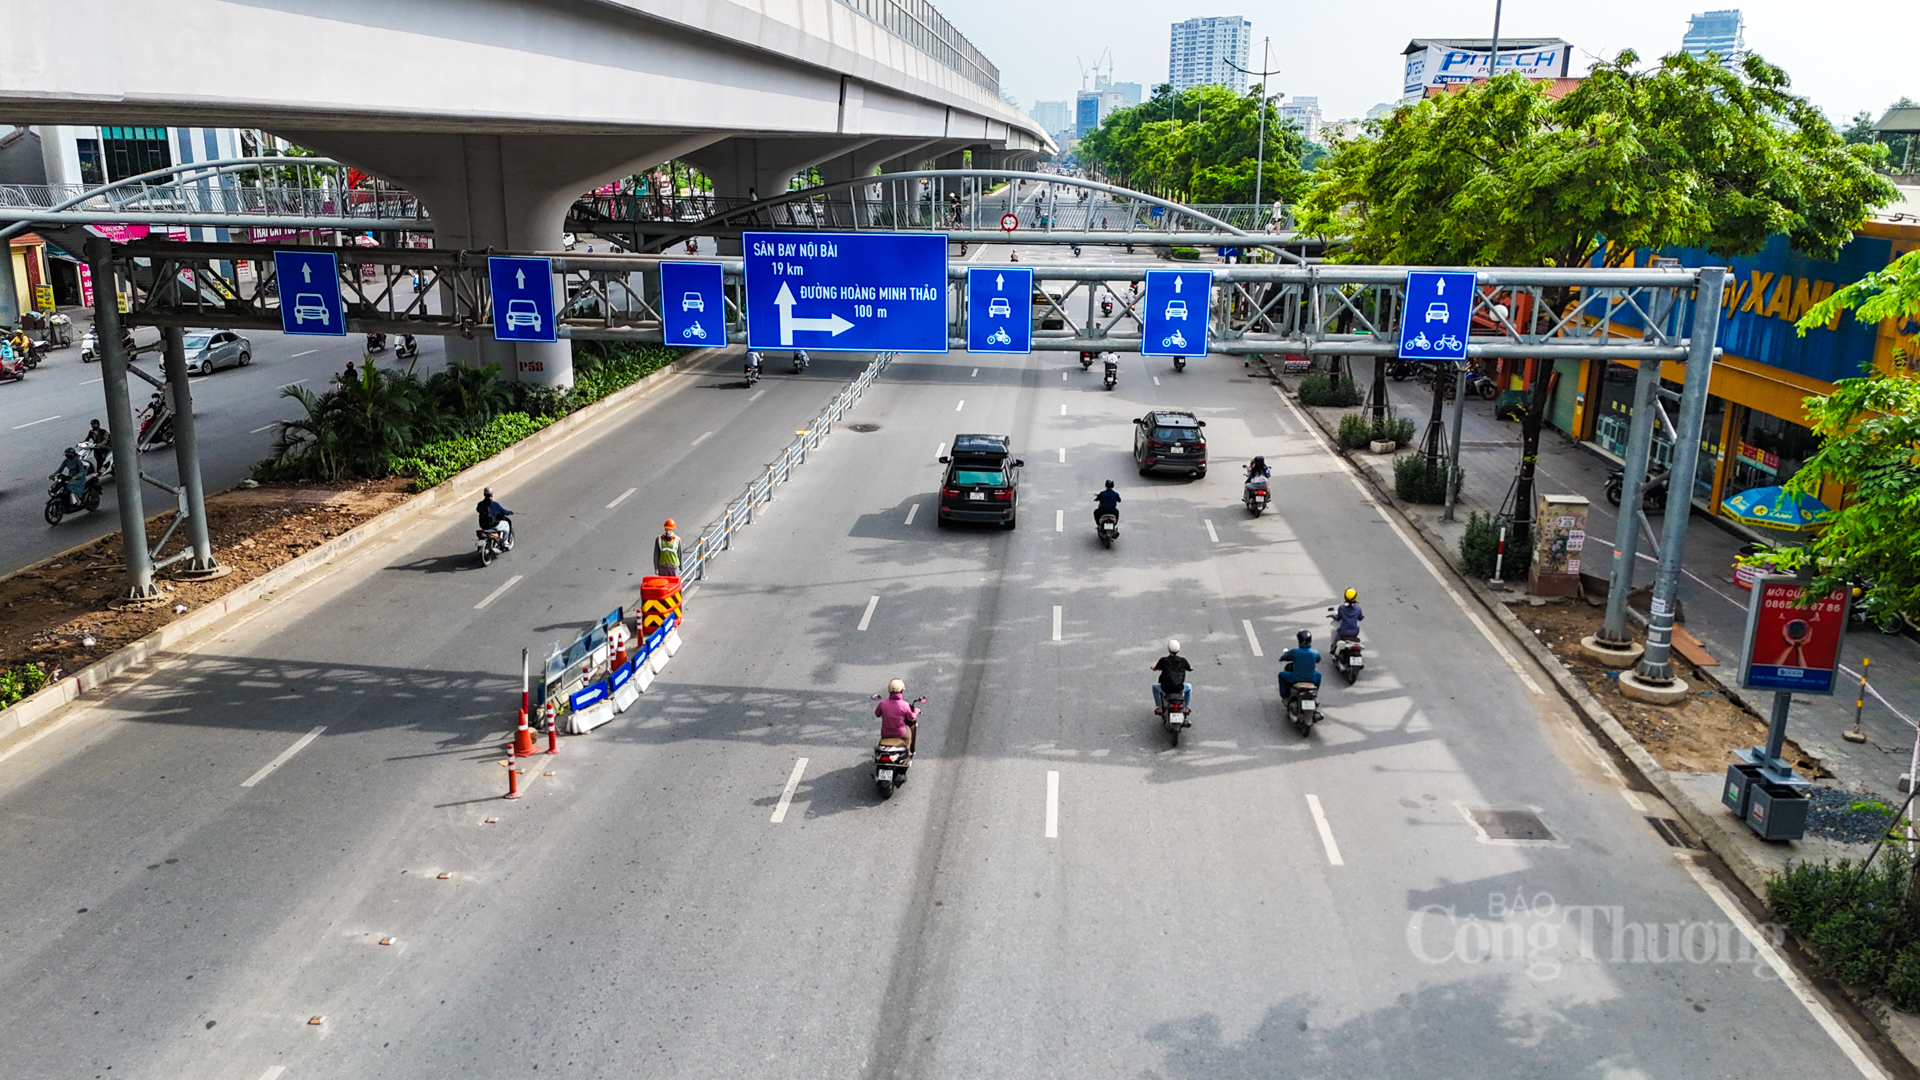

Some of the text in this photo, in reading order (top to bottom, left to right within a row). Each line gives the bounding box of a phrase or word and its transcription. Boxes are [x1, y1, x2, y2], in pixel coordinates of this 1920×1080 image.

[1440, 51, 1555, 71] PITECH
[753, 240, 838, 260] SÂN BAY NỘI BÀI
[771, 261, 804, 276] 19 km
[800, 282, 937, 301] ĐƯỜNG HOÀNG MINH THẢO
[853, 304, 887, 318] 100 m
[518, 361, 544, 372] P58
